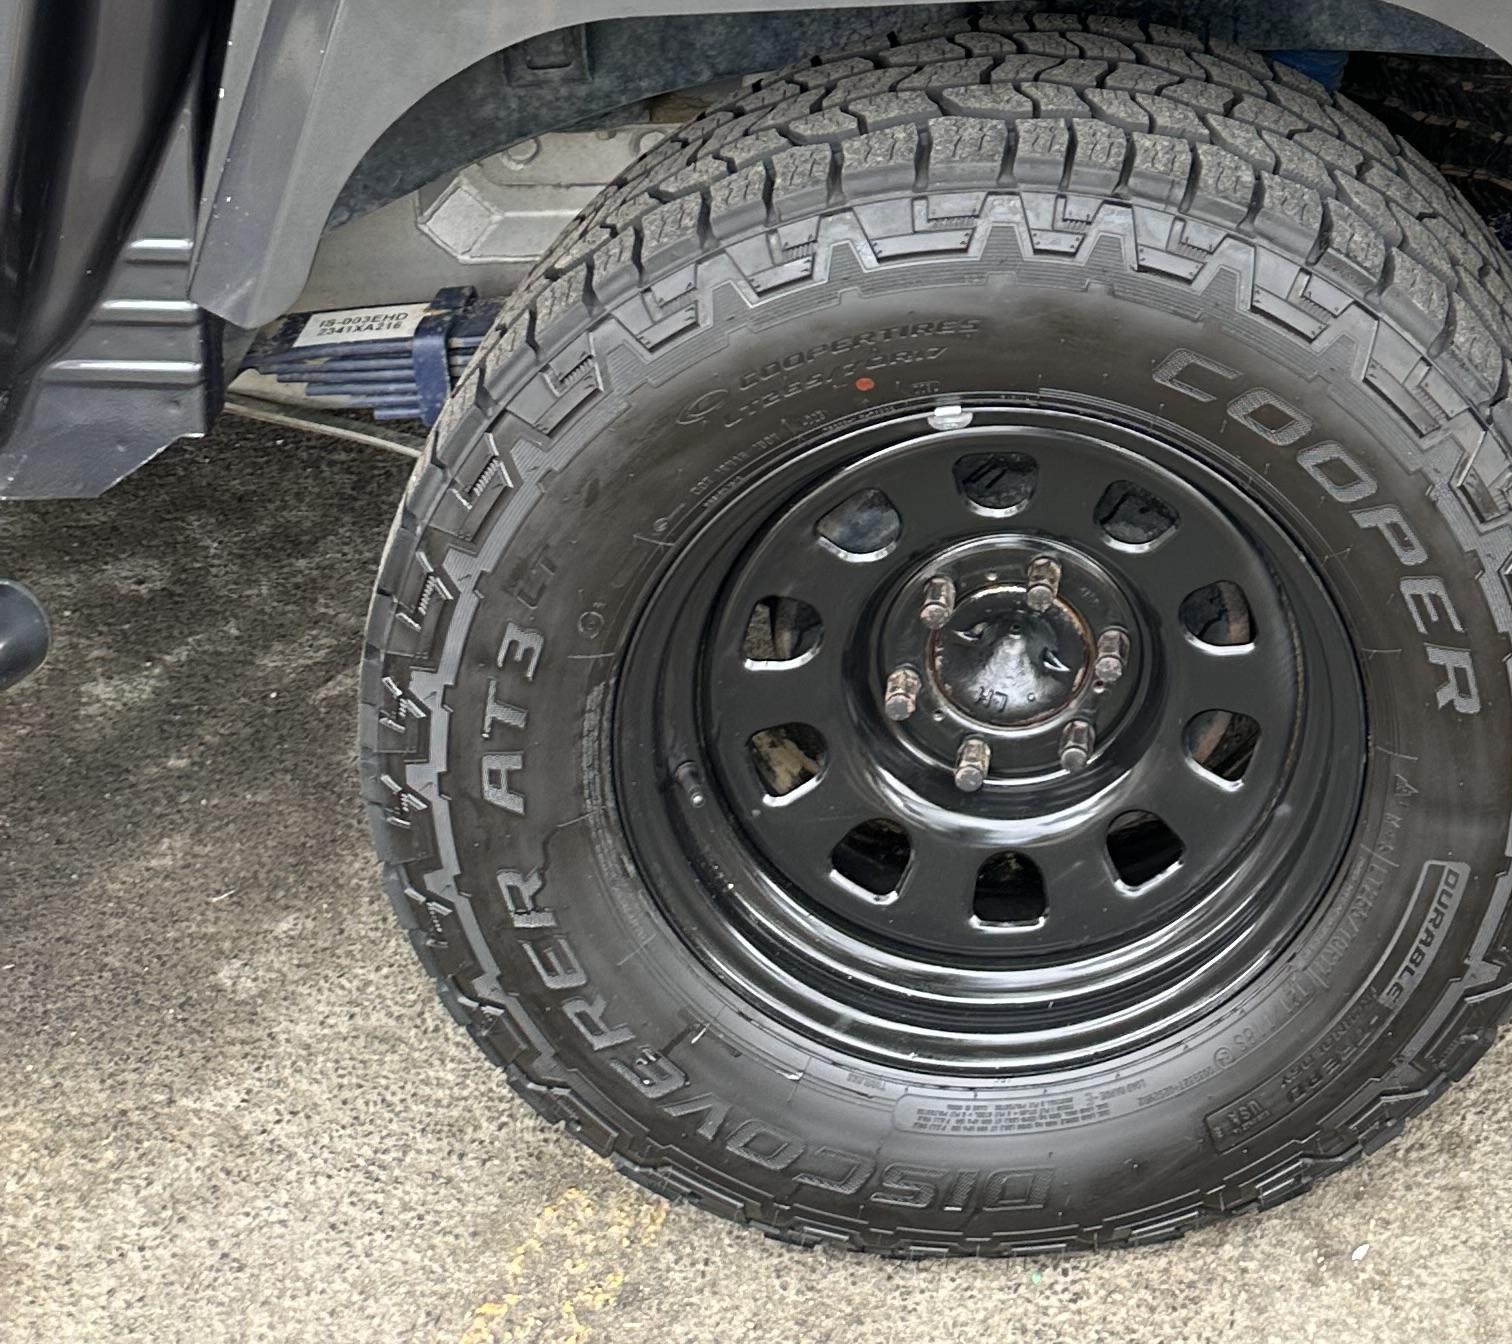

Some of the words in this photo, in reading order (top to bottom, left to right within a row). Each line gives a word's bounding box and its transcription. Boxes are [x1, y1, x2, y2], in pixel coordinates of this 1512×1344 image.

[1152, 348, 1482, 715] COOPER
[481, 621, 545, 816] AT3
[496, 867, 1055, 1212] DISCOVERER
[1386, 867, 1461, 1002] DURABLE
